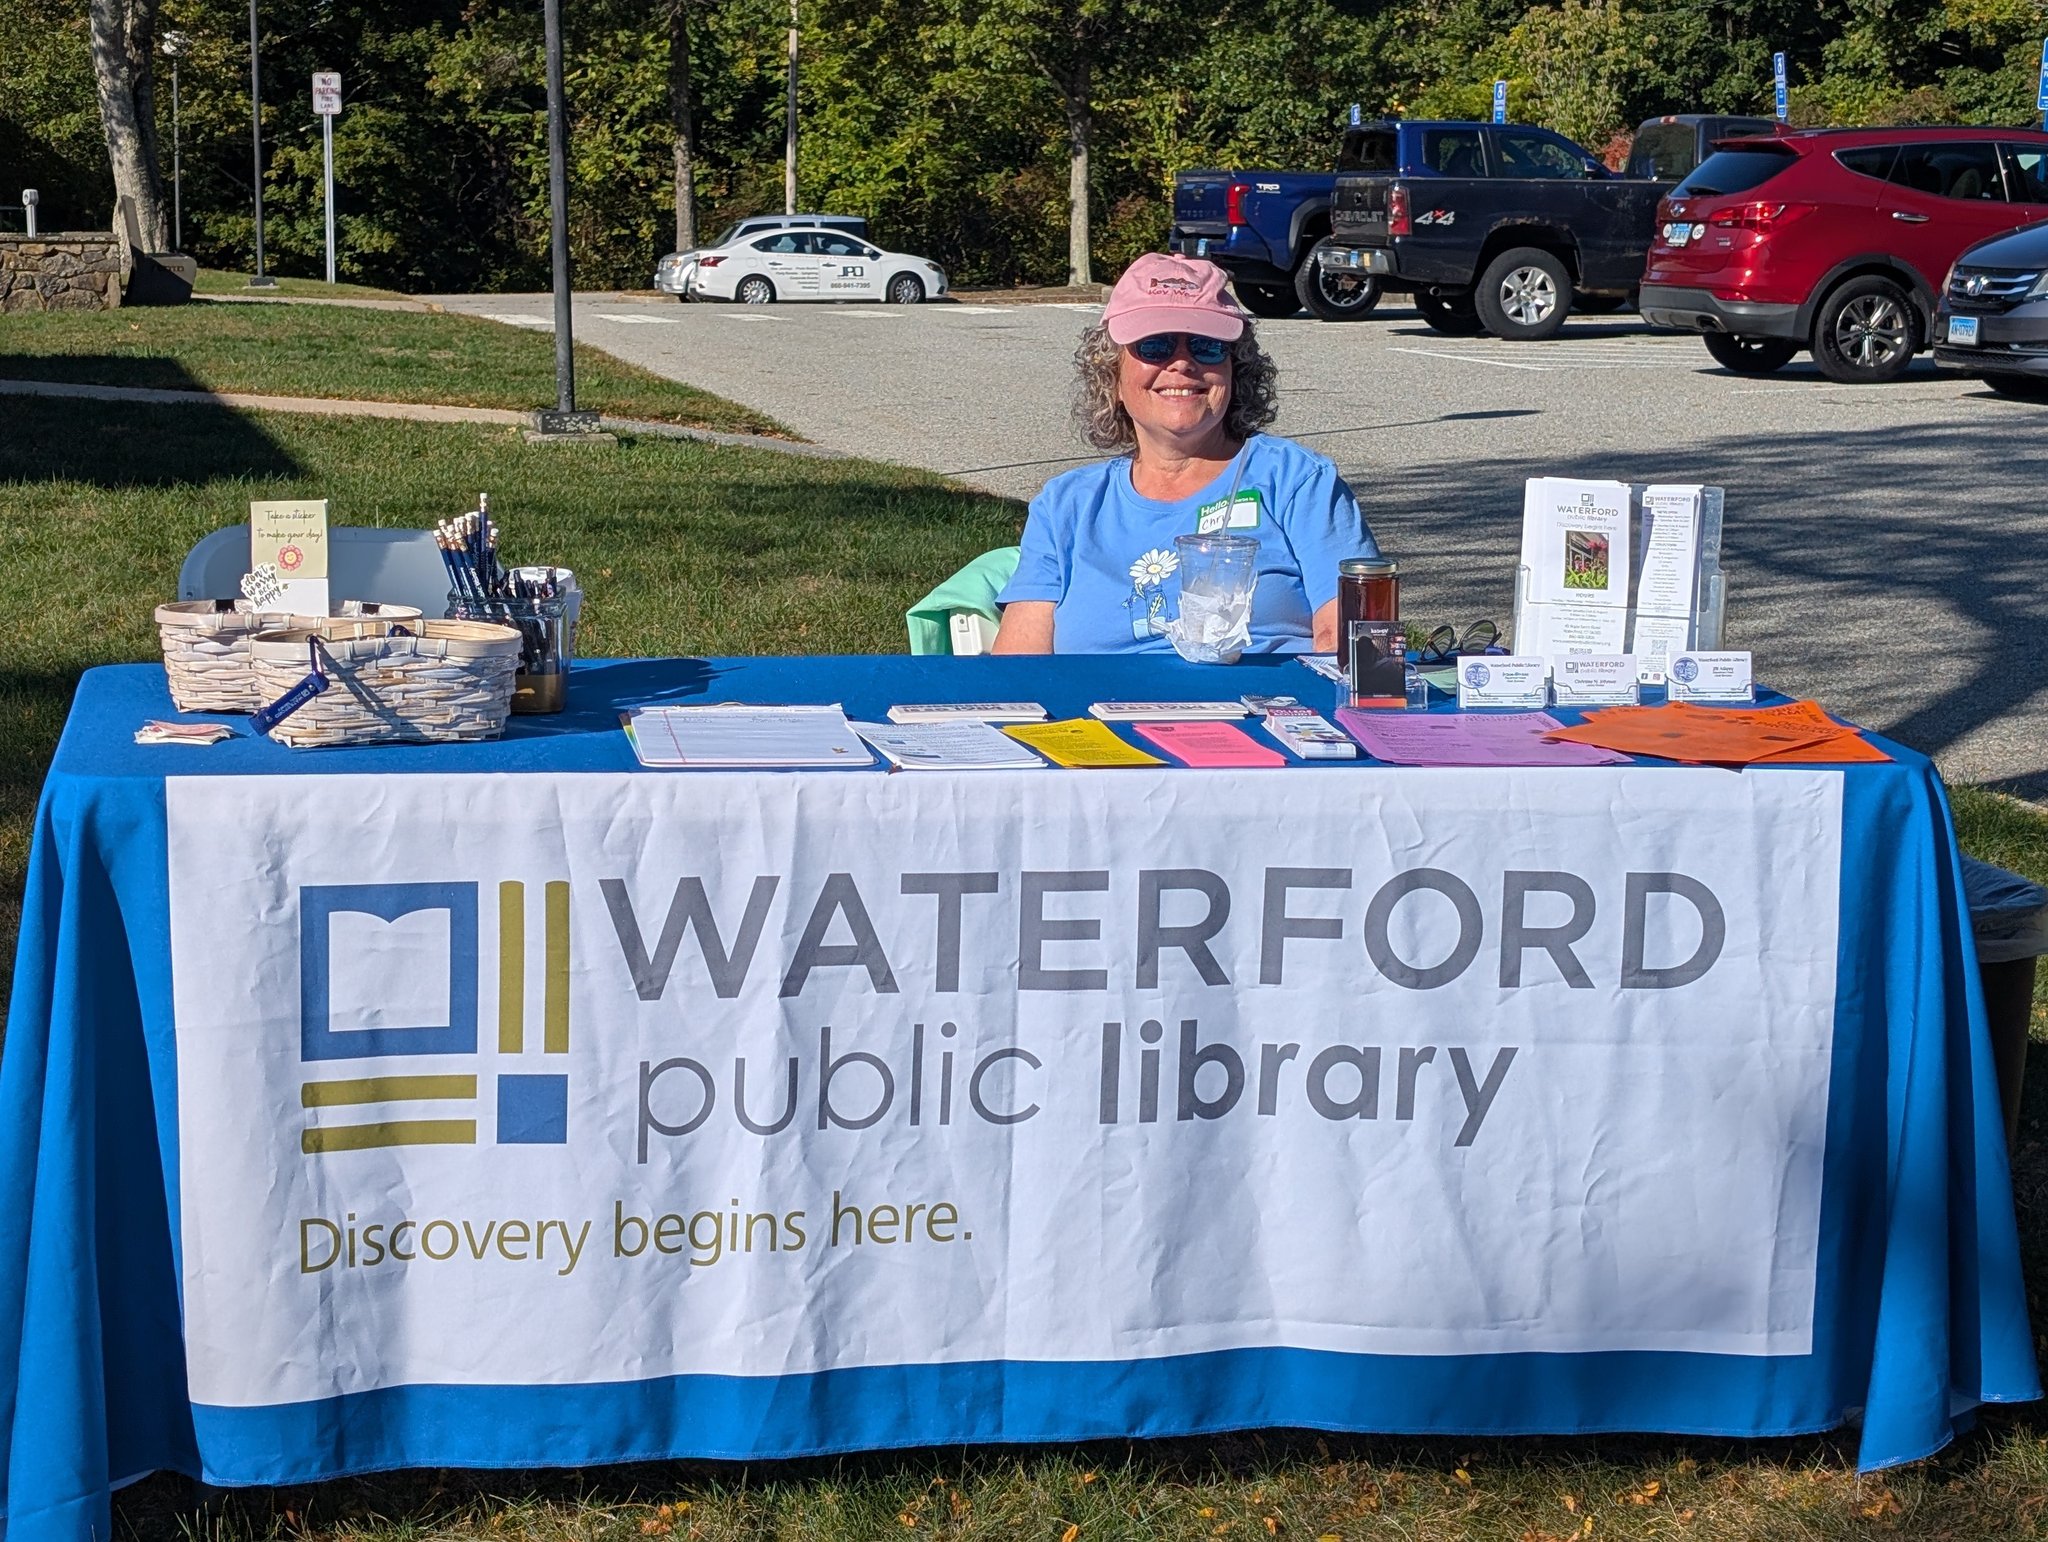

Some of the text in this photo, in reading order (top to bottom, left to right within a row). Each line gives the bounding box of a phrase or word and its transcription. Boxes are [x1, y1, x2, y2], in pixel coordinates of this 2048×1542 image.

[321, 77, 332, 86] NO
[315, 87, 341, 95] PARKING
[1255, 183, 1280, 191] TRD
[1335, 210, 1384, 222] CHEVROLET
[265, 510, 284, 525] Take
[292, 509, 317, 525] sticker
[1557, 505, 1618, 517] WATERFORD
[1586, 515, 1608, 523] library
[266, 530, 286, 543] make
[287, 532, 304, 543] your
[305, 528, 323, 543] day!
[246, 571, 277, 597] worry
[253, 584, 282, 608] happy
[599, 867, 1726, 1000] WATERFORD
[635, 1020, 1519, 1164] public library
[301, 1190, 974, 1276] Discovery begins here.
